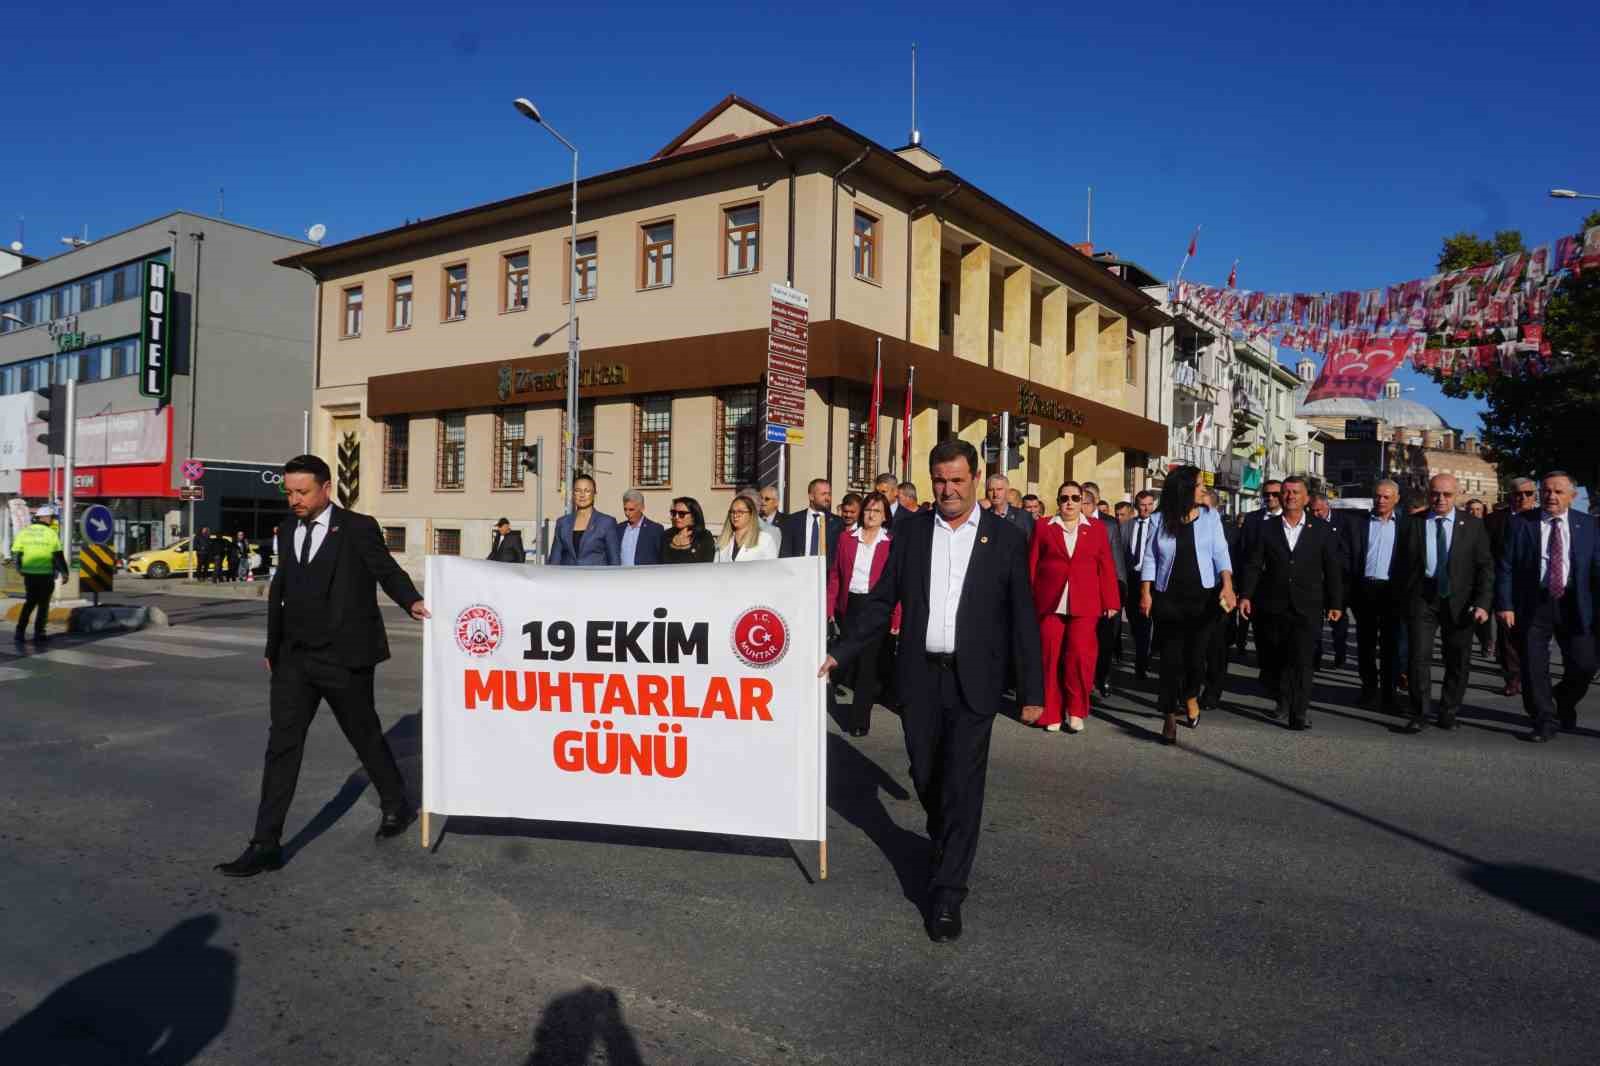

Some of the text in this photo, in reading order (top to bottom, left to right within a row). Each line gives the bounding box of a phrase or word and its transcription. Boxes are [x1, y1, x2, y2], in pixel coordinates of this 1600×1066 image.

[148, 263, 165, 393] HOTEL
[523, 621, 575, 661] 19
[586, 608, 708, 664] EKİM
[739, 641, 778, 659] MUHTAR
[465, 670, 772, 722] MUHTARLAR
[554, 720, 687, 777] GÜNÜ
